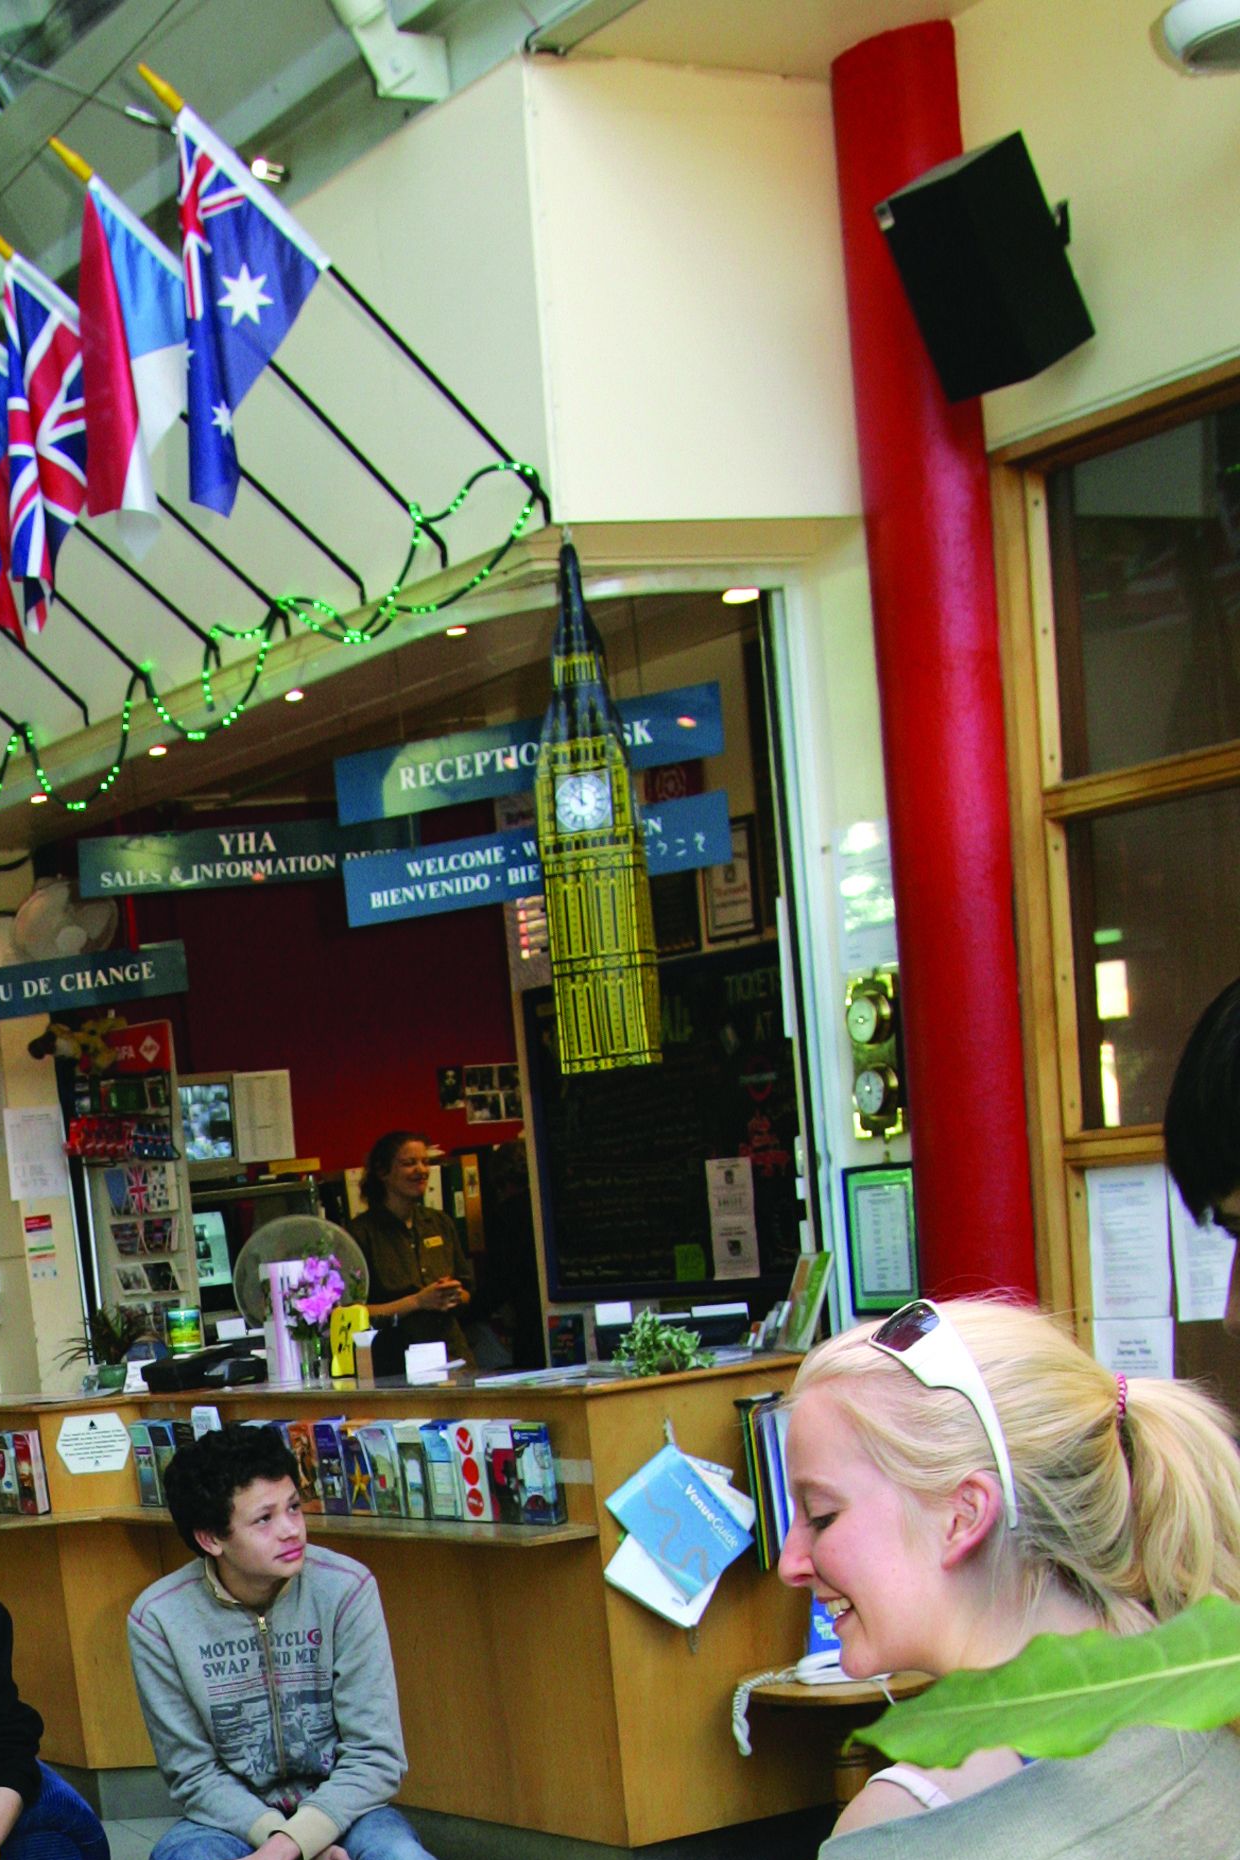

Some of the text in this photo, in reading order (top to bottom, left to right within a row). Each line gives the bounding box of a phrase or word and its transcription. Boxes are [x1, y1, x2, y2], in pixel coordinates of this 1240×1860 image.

[399, 741, 543, 791] RECEPTIO
[218, 831, 277, 855] YHA
[100, 871, 161, 888] SALES
[170, 866, 183, 882] &
[191, 853, 337, 881] INFORMATION
[406, 846, 505, 878] WELCOME
[370, 873, 491, 909] BIENVENIDO
[22, 977, 53, 998] DE
[60, 961, 156, 992] CHANGE
[684, 1483, 739, 1548] VenueGuide
[202, 1658, 250, 1678] SWAP
